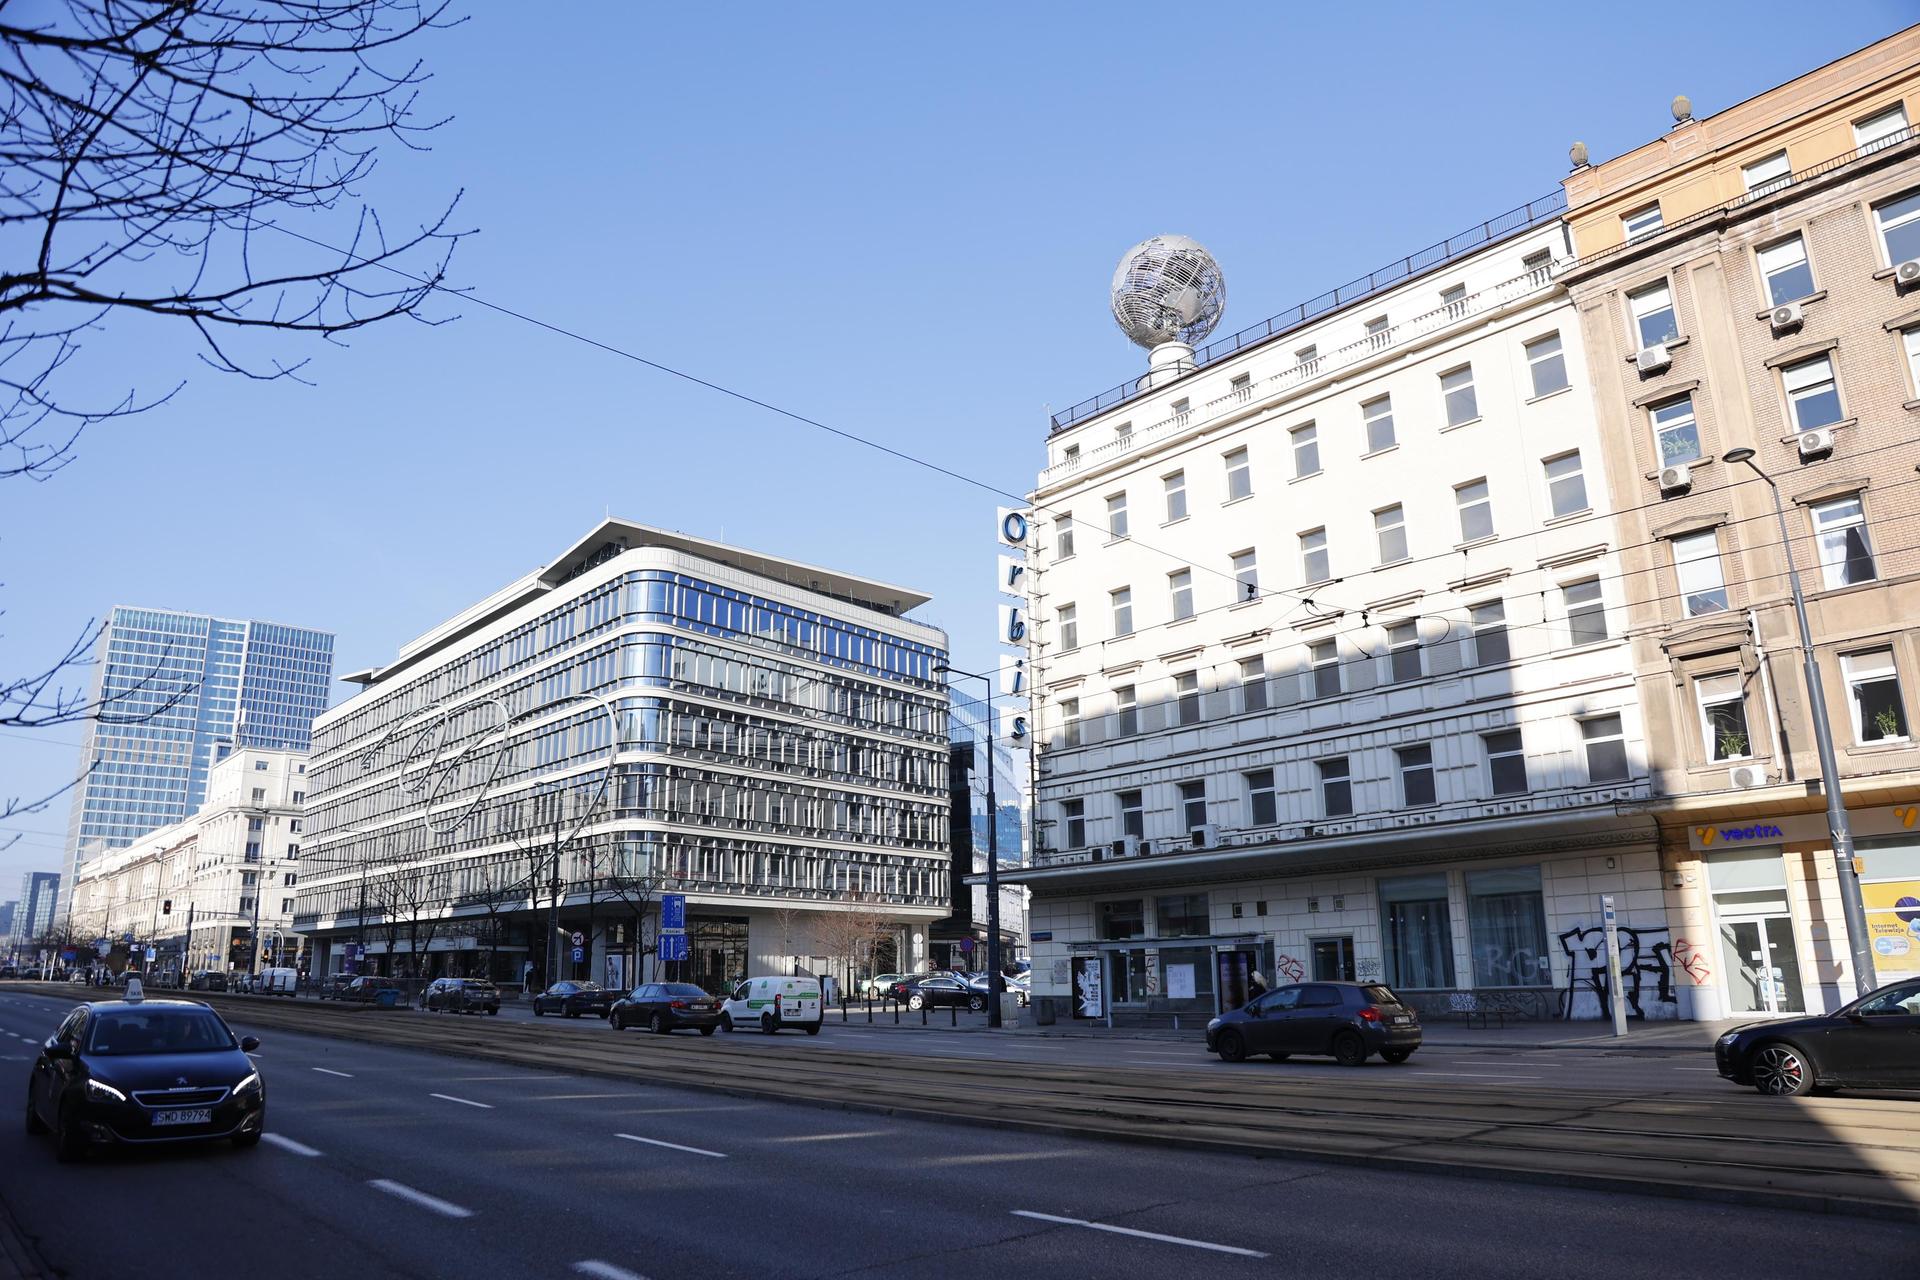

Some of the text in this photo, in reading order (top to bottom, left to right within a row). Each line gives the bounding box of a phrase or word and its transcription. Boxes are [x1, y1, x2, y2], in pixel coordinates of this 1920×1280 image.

[1001, 512, 1027, 740] Orbis
[1720, 824, 1783, 841] vectra
[158, 1110, 211, 1122] SWD 89794
